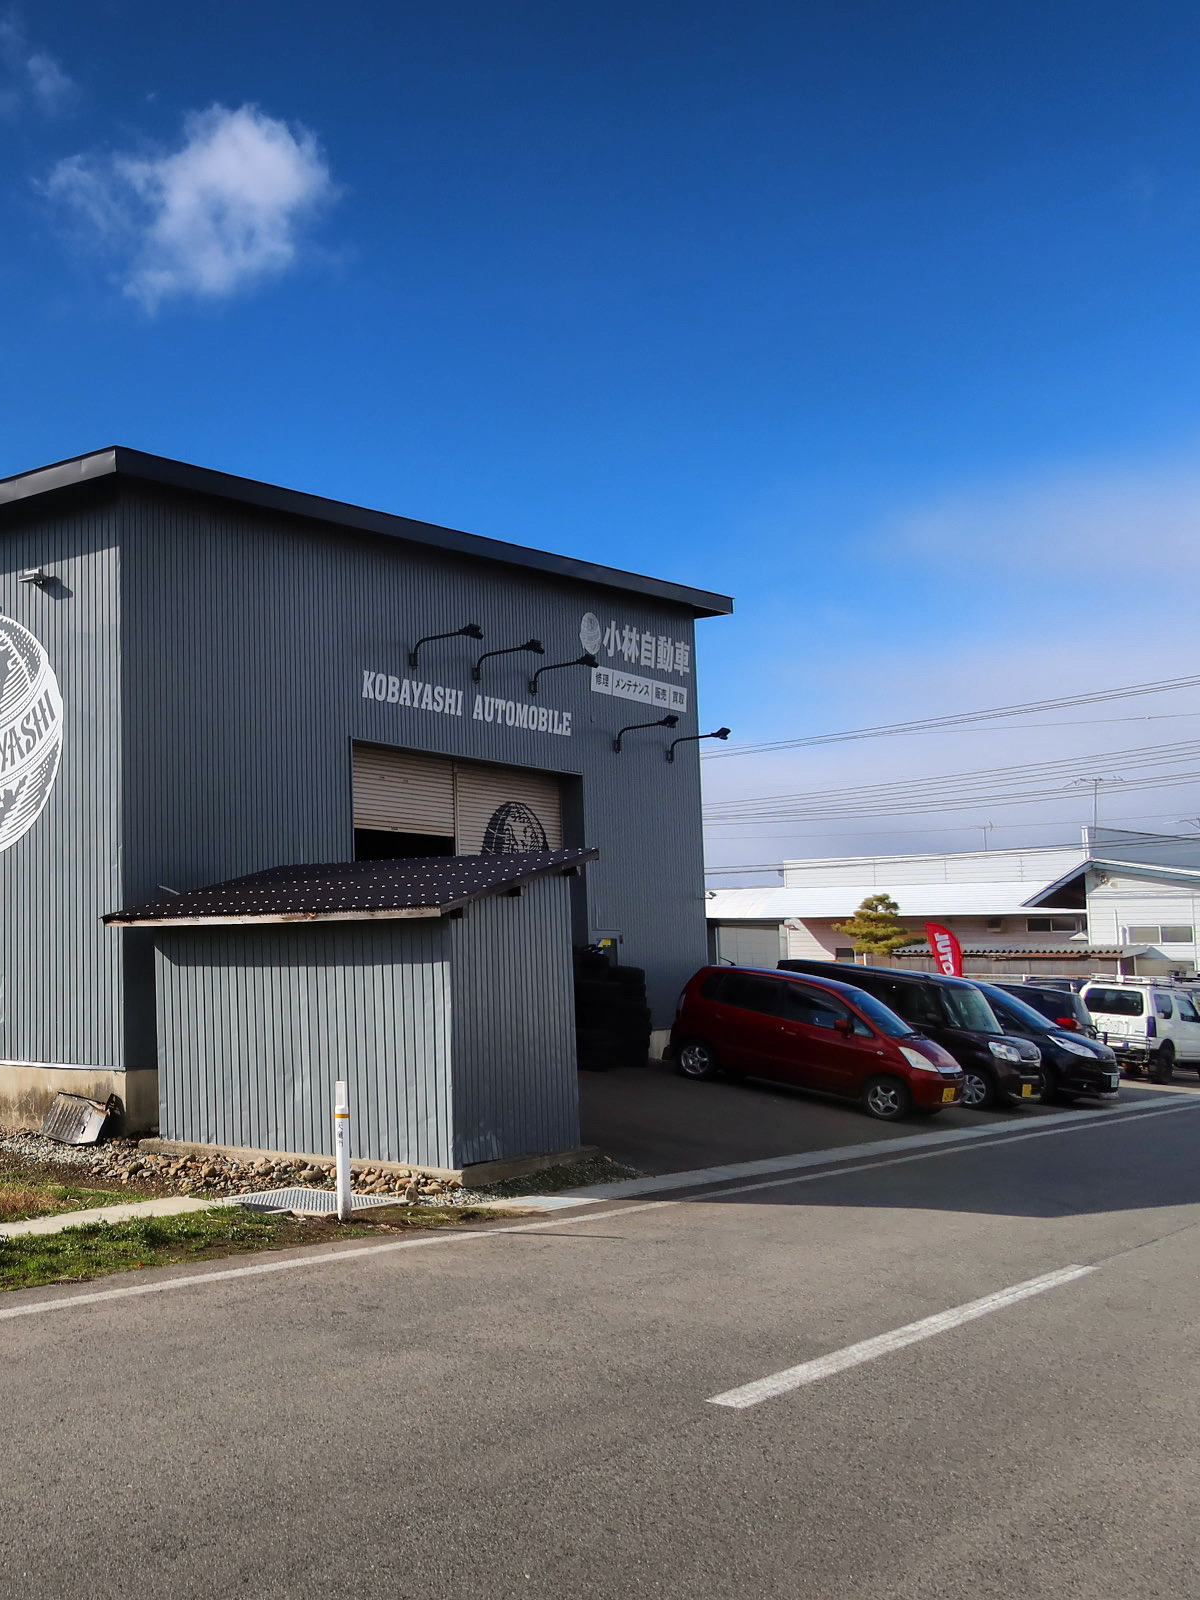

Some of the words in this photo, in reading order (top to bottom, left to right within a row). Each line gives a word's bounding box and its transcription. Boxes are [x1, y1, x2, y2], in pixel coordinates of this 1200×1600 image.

[602, 620, 690, 677] 小林自動車
[362, 670, 463, 717] KOBAYASHI
[472, 694, 572, 737] AUTOMOBILE
[595, 672, 609, 688] 修理
[615, 678, 650, 696] メンテナンス
[933, 932, 954, 976] OTUL
